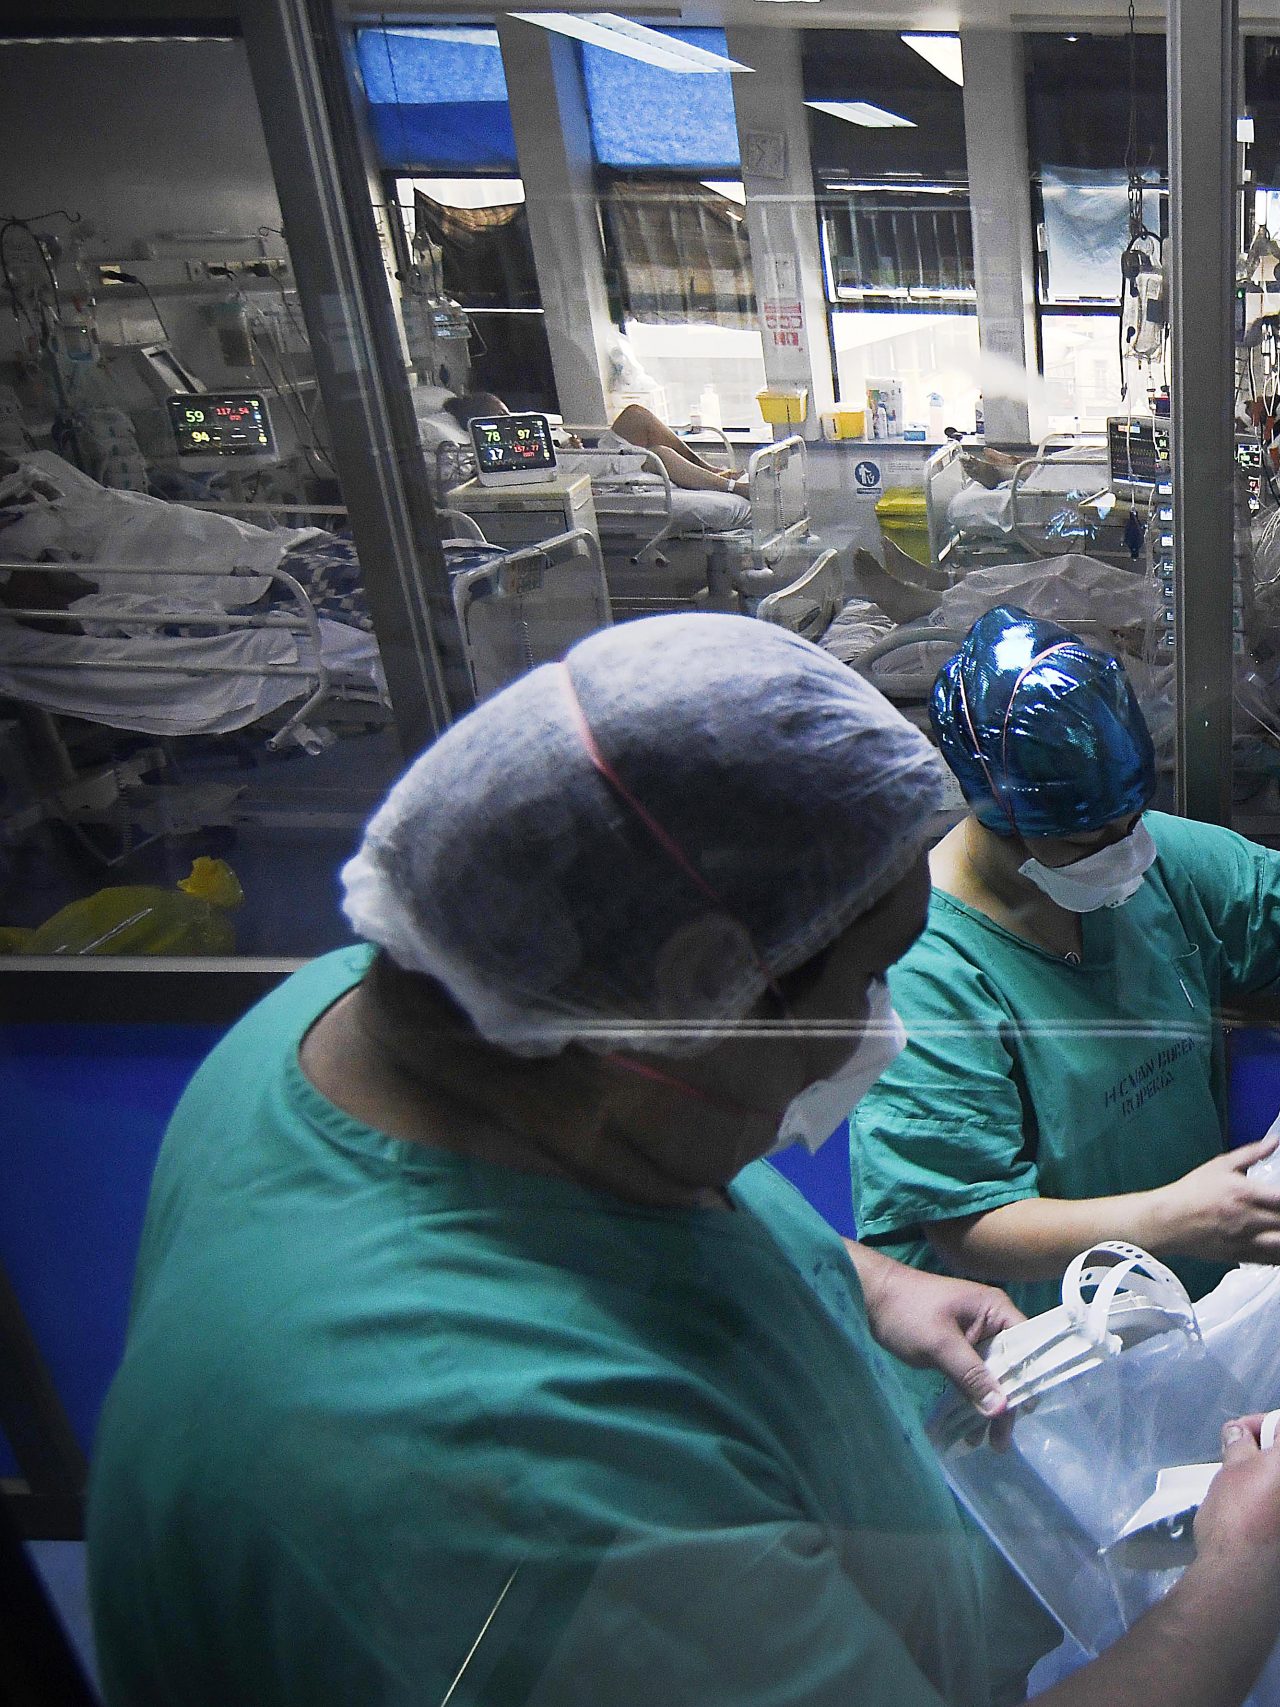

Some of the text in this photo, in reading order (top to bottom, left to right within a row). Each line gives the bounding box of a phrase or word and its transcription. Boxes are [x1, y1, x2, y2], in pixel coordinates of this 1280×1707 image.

[185, 411, 204, 422] 59
[192, 432, 210, 442] 94
[485, 430, 531, 442] 78 97
[489, 449, 504, 460] 17
